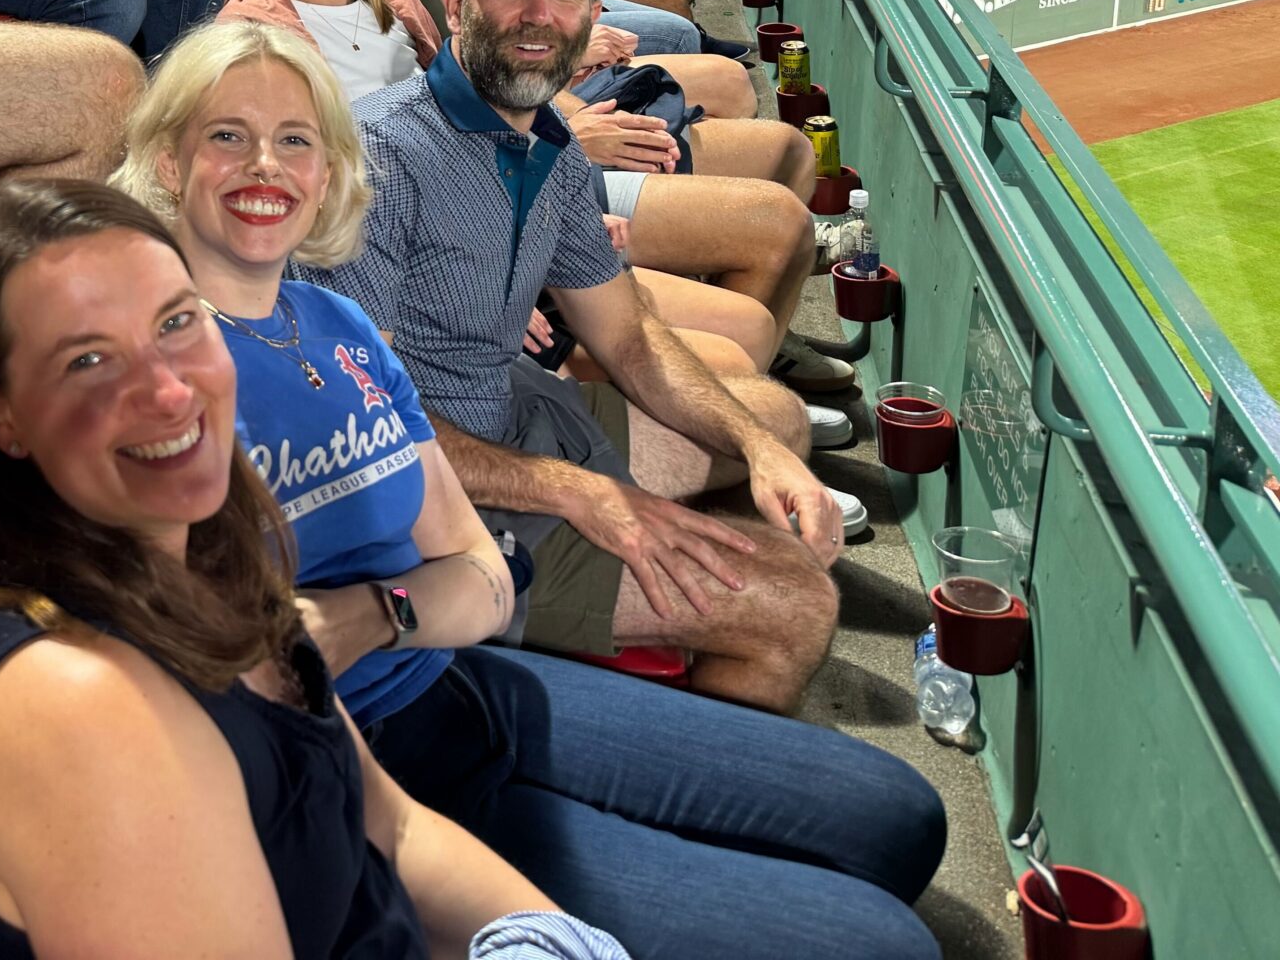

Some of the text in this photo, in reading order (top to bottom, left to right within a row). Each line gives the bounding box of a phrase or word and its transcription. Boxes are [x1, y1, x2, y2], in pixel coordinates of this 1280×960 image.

[1002, 360, 1018, 401] OUT
[311, 470, 369, 505] LEAGUE
[987, 455, 1008, 508] OVER
[998, 436, 1009, 470] DO
[1011, 467, 1029, 512] NOT
